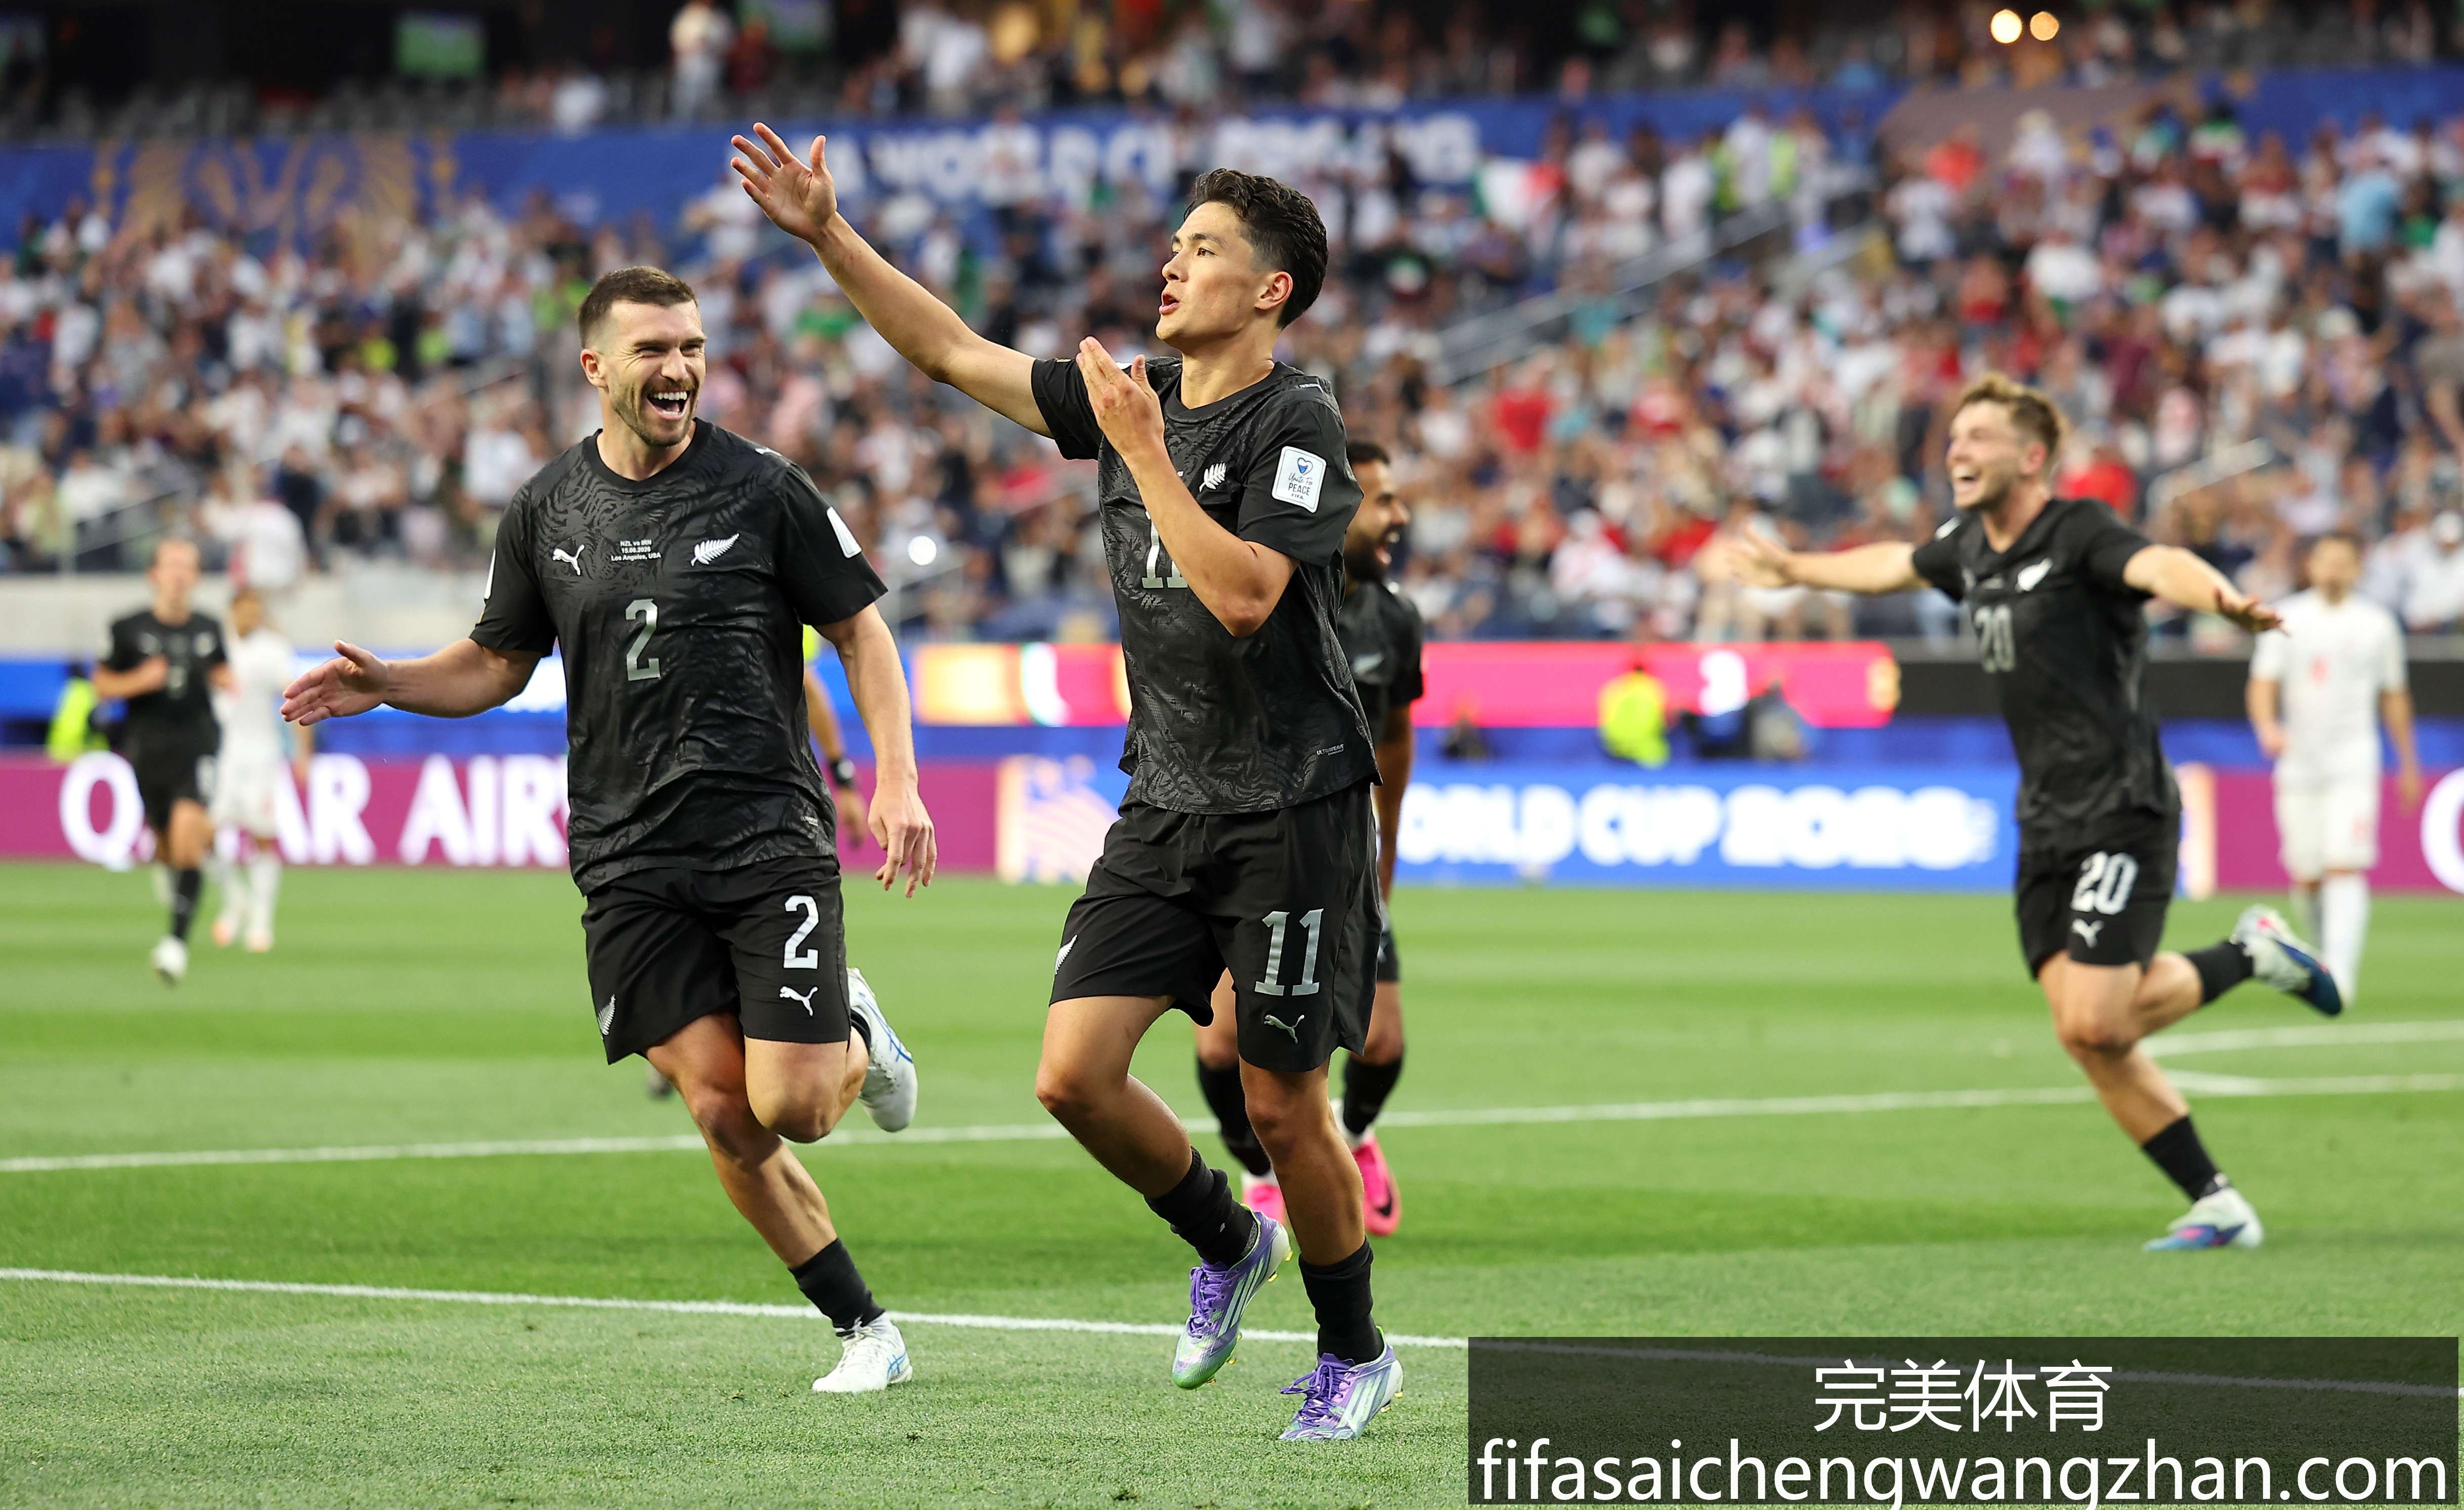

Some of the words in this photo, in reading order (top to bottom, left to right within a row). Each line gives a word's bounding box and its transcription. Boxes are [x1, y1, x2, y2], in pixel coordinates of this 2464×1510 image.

[1288, 482, 1311, 495] PEACE
[626, 599, 660, 681] 2
[1974, 604, 2016, 674] 20
[59, 749, 377, 872] QAR
[398, 752, 570, 868] AIR
[1395, 783, 1578, 864] ORLD
[1579, 784, 1722, 865] CUP
[2070, 850, 2139, 915] 20
[783, 895, 819, 970] 2
[1254, 908, 1324, 996] 11
